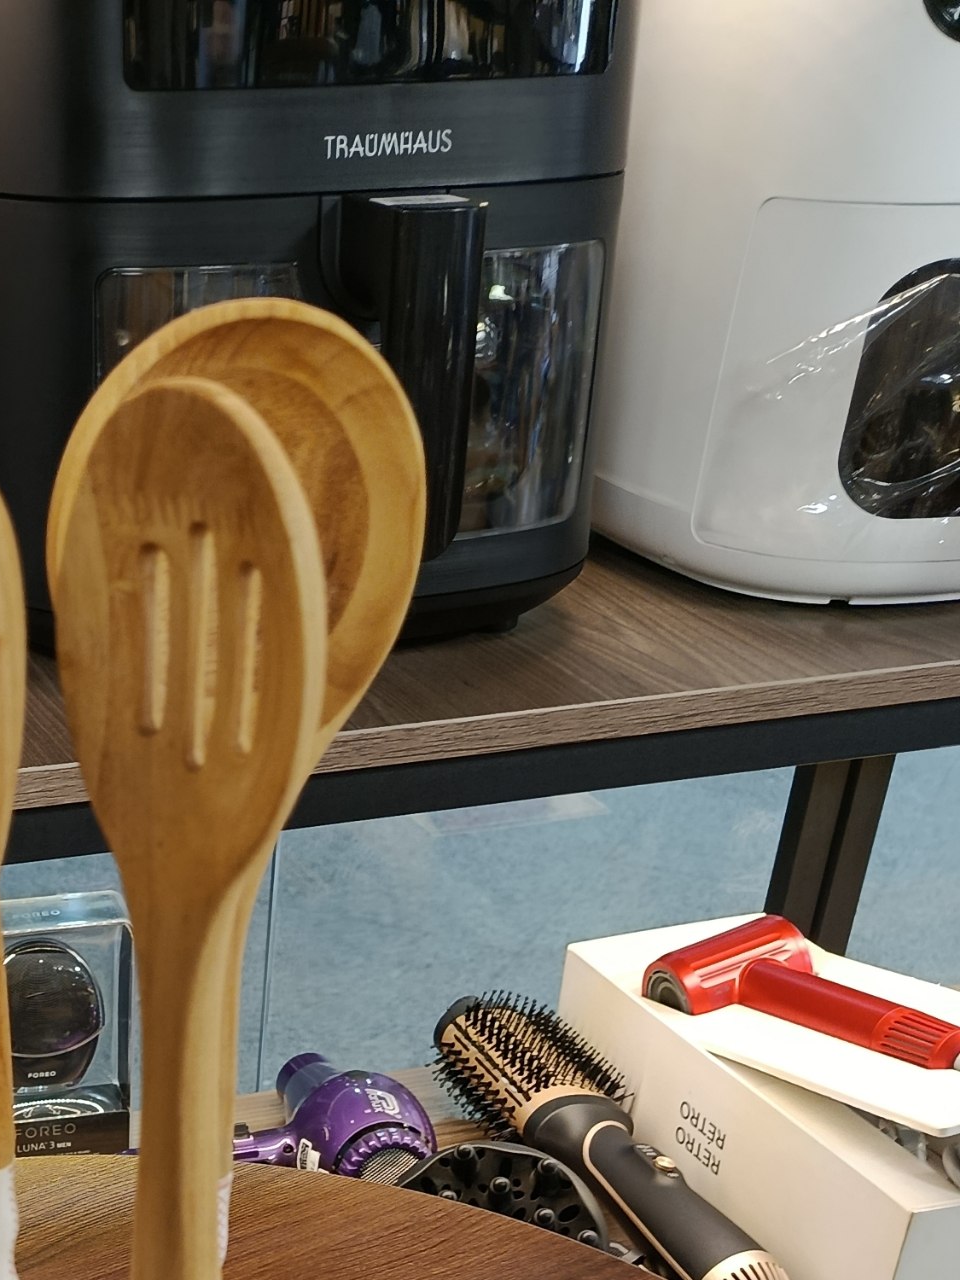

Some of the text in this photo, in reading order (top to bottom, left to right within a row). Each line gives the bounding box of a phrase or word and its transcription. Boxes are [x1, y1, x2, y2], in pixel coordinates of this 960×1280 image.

[27, 1070, 57, 1079] FOREO
[680, 1101, 727, 1150] RÉTRO
[49, 1140, 55, 1149] 3
[675, 1126, 721, 1176] RETRO
